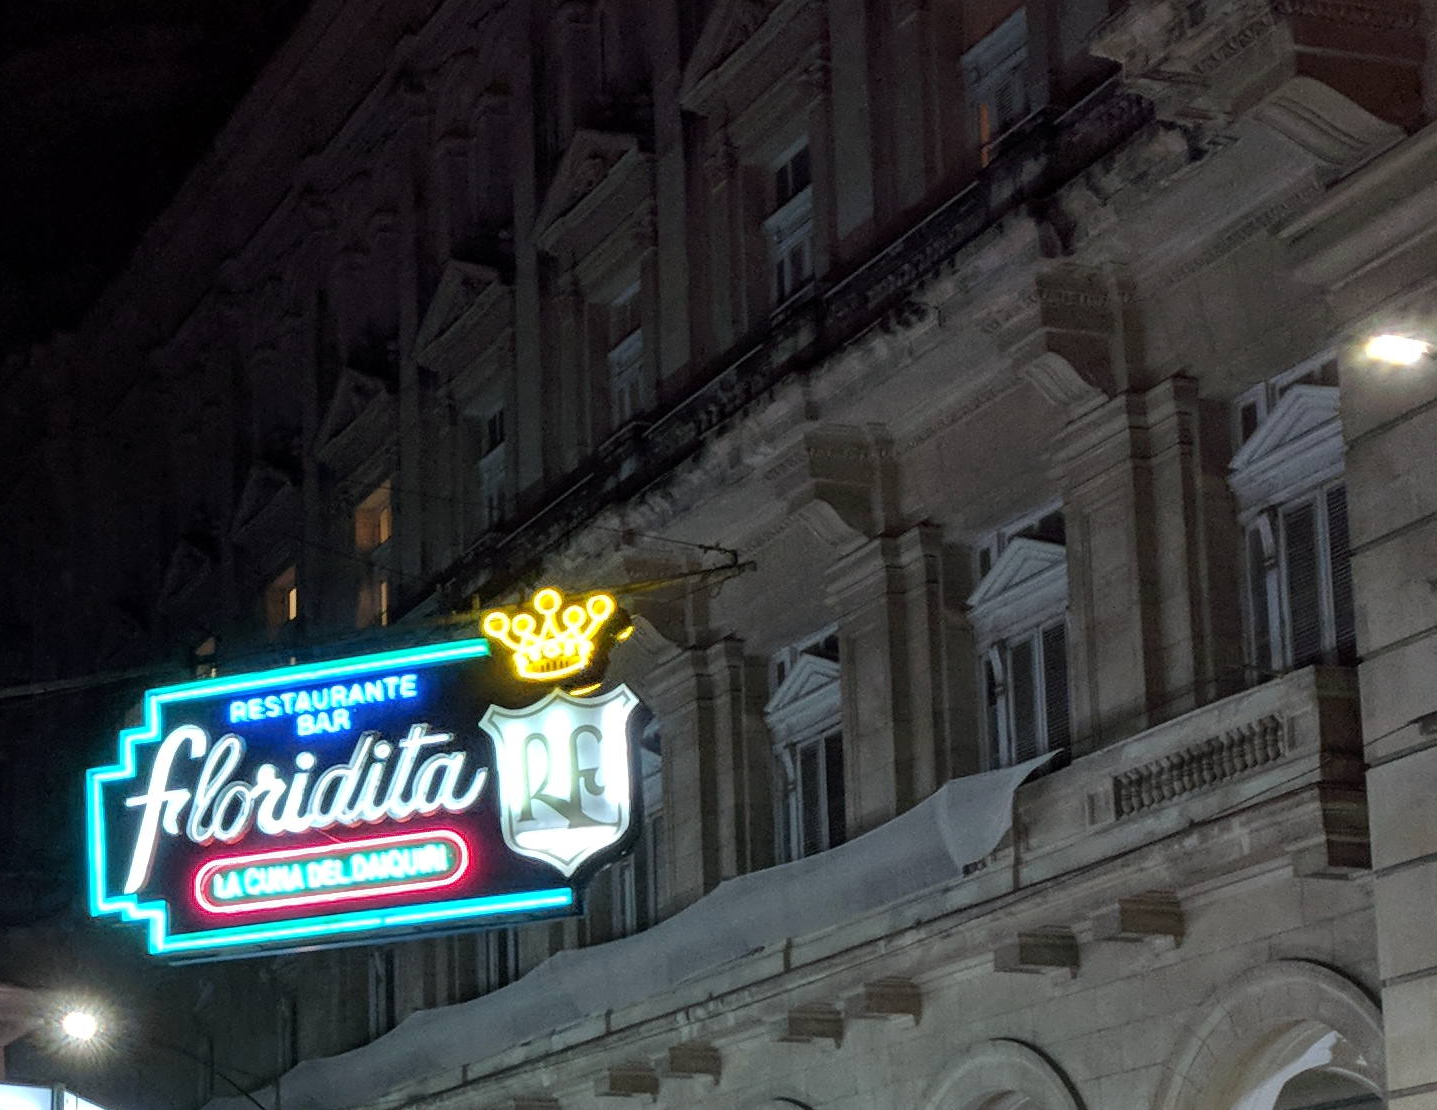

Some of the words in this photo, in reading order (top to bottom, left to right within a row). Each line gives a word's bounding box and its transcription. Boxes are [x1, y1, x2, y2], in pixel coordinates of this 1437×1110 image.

[229, 674, 417, 722] RESTAURANTE
[296, 708, 350, 736] BAR
[212, 870, 243, 899] LA
[244, 863, 304, 895] CUNA
[306, 858, 350, 889] DEL
